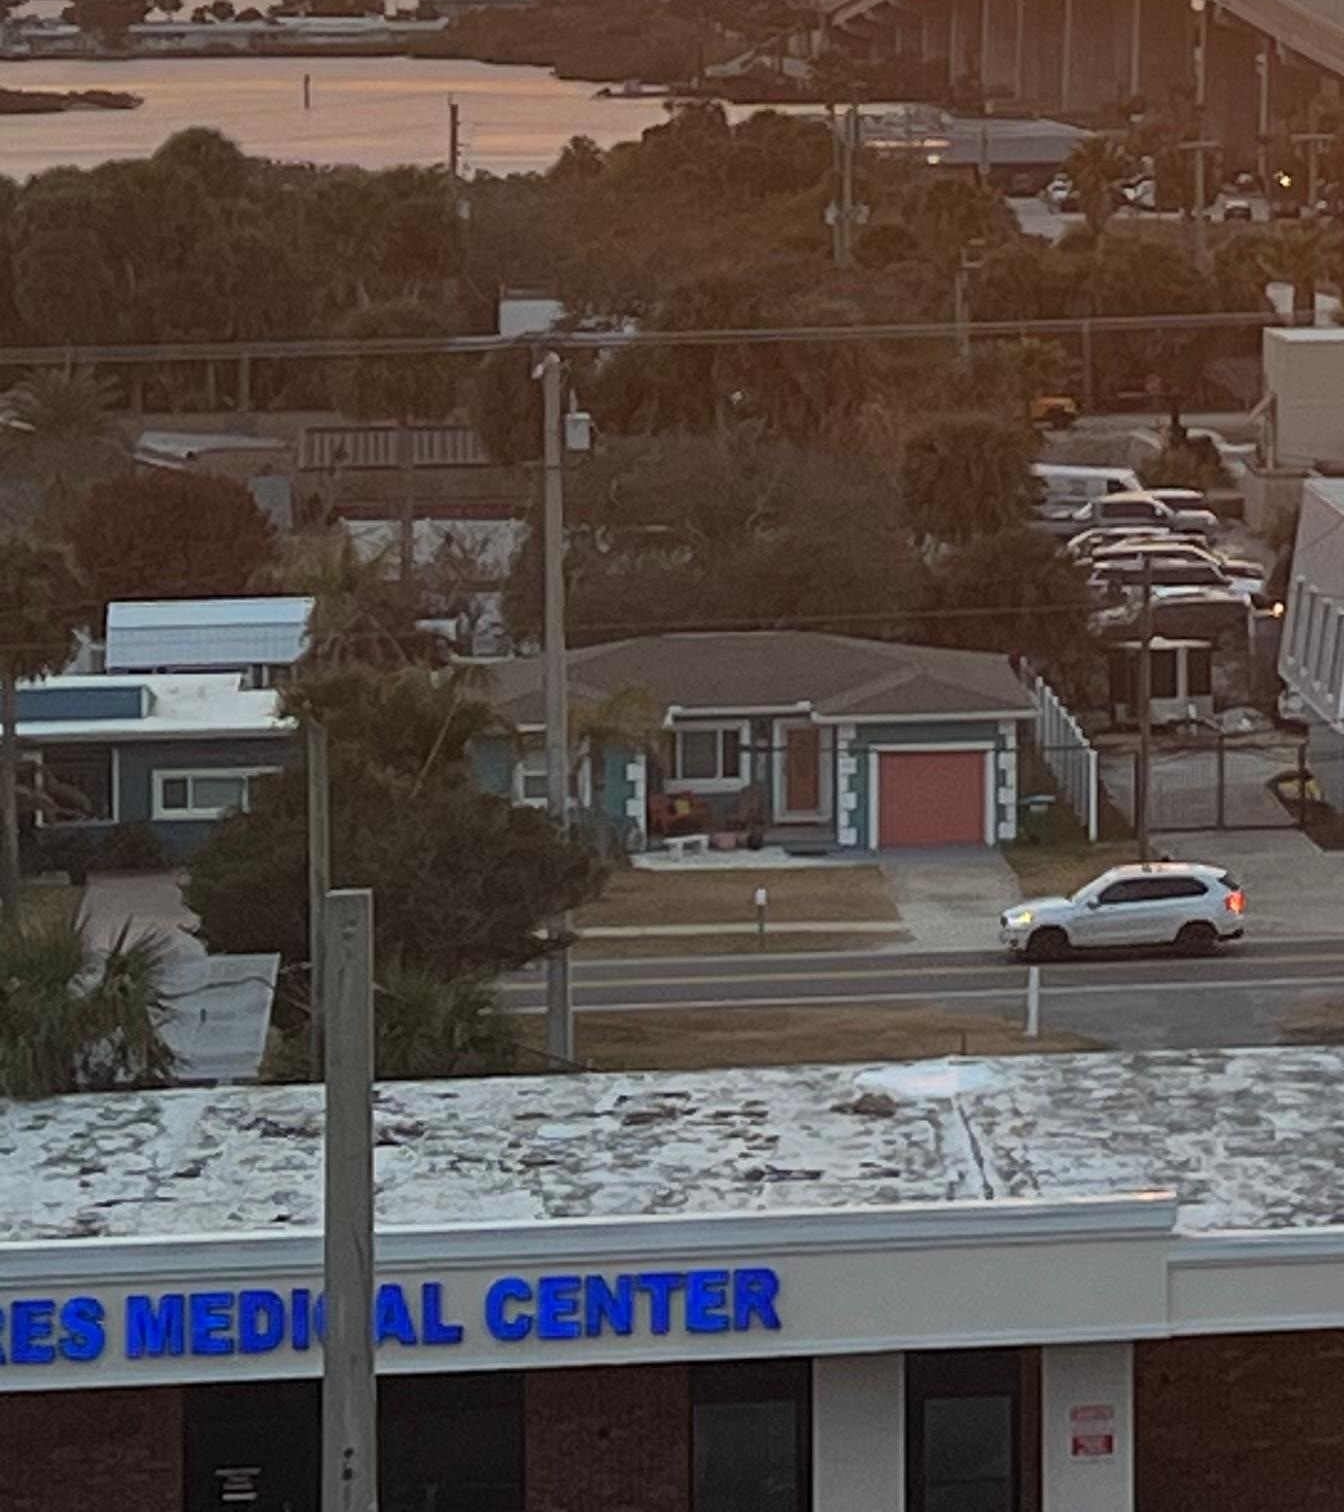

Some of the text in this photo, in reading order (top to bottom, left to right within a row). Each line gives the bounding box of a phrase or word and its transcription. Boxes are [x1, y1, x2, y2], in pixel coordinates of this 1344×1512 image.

[0, 1266, 781, 1365] ES MEDIAL CENTER
